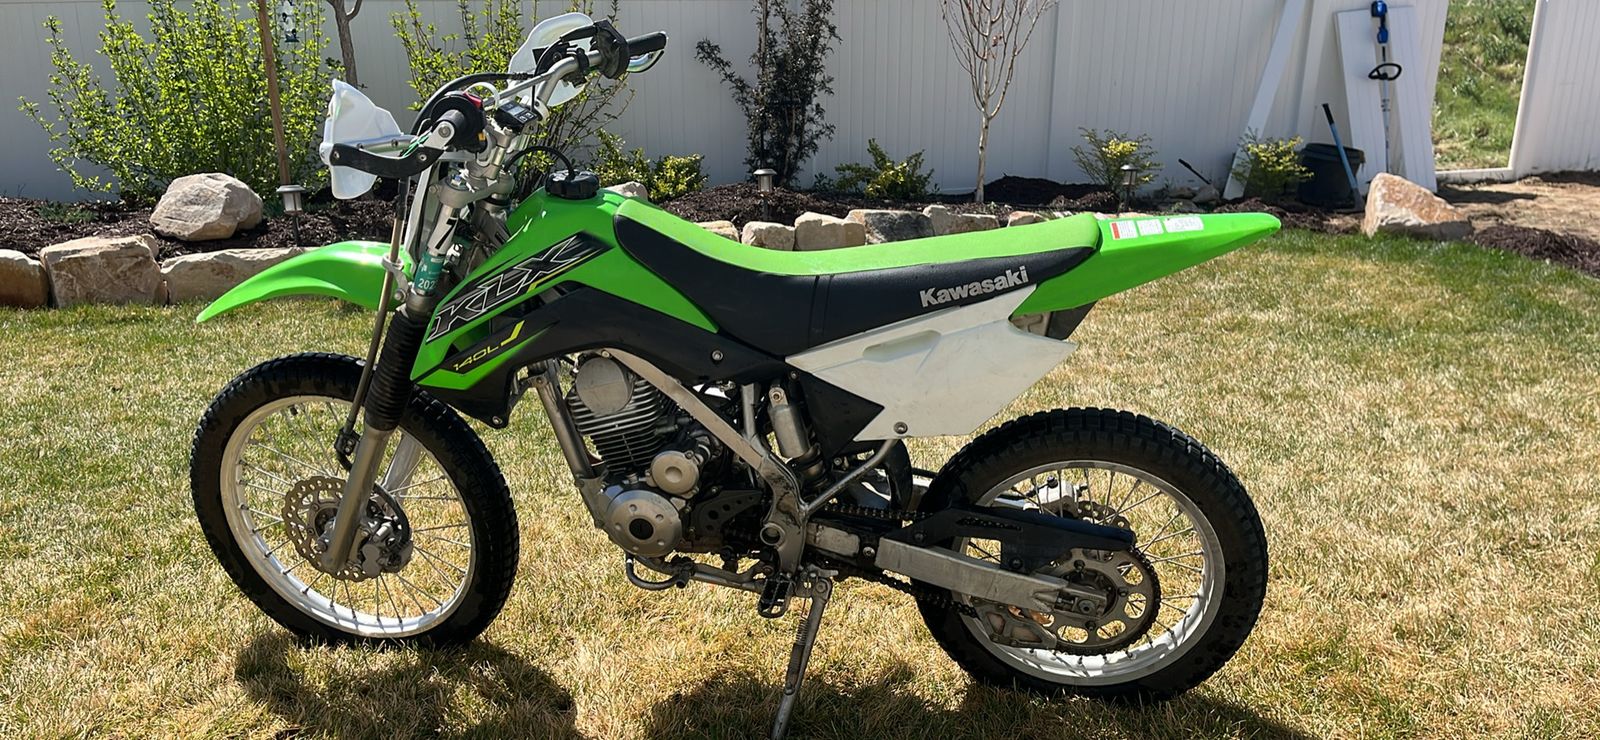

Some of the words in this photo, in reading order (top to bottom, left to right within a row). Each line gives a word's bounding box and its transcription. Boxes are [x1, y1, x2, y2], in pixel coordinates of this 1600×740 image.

[426, 235, 581, 342] KLX
[920, 265, 1029, 308] Kawasaki
[453, 344, 500, 371] 140L
